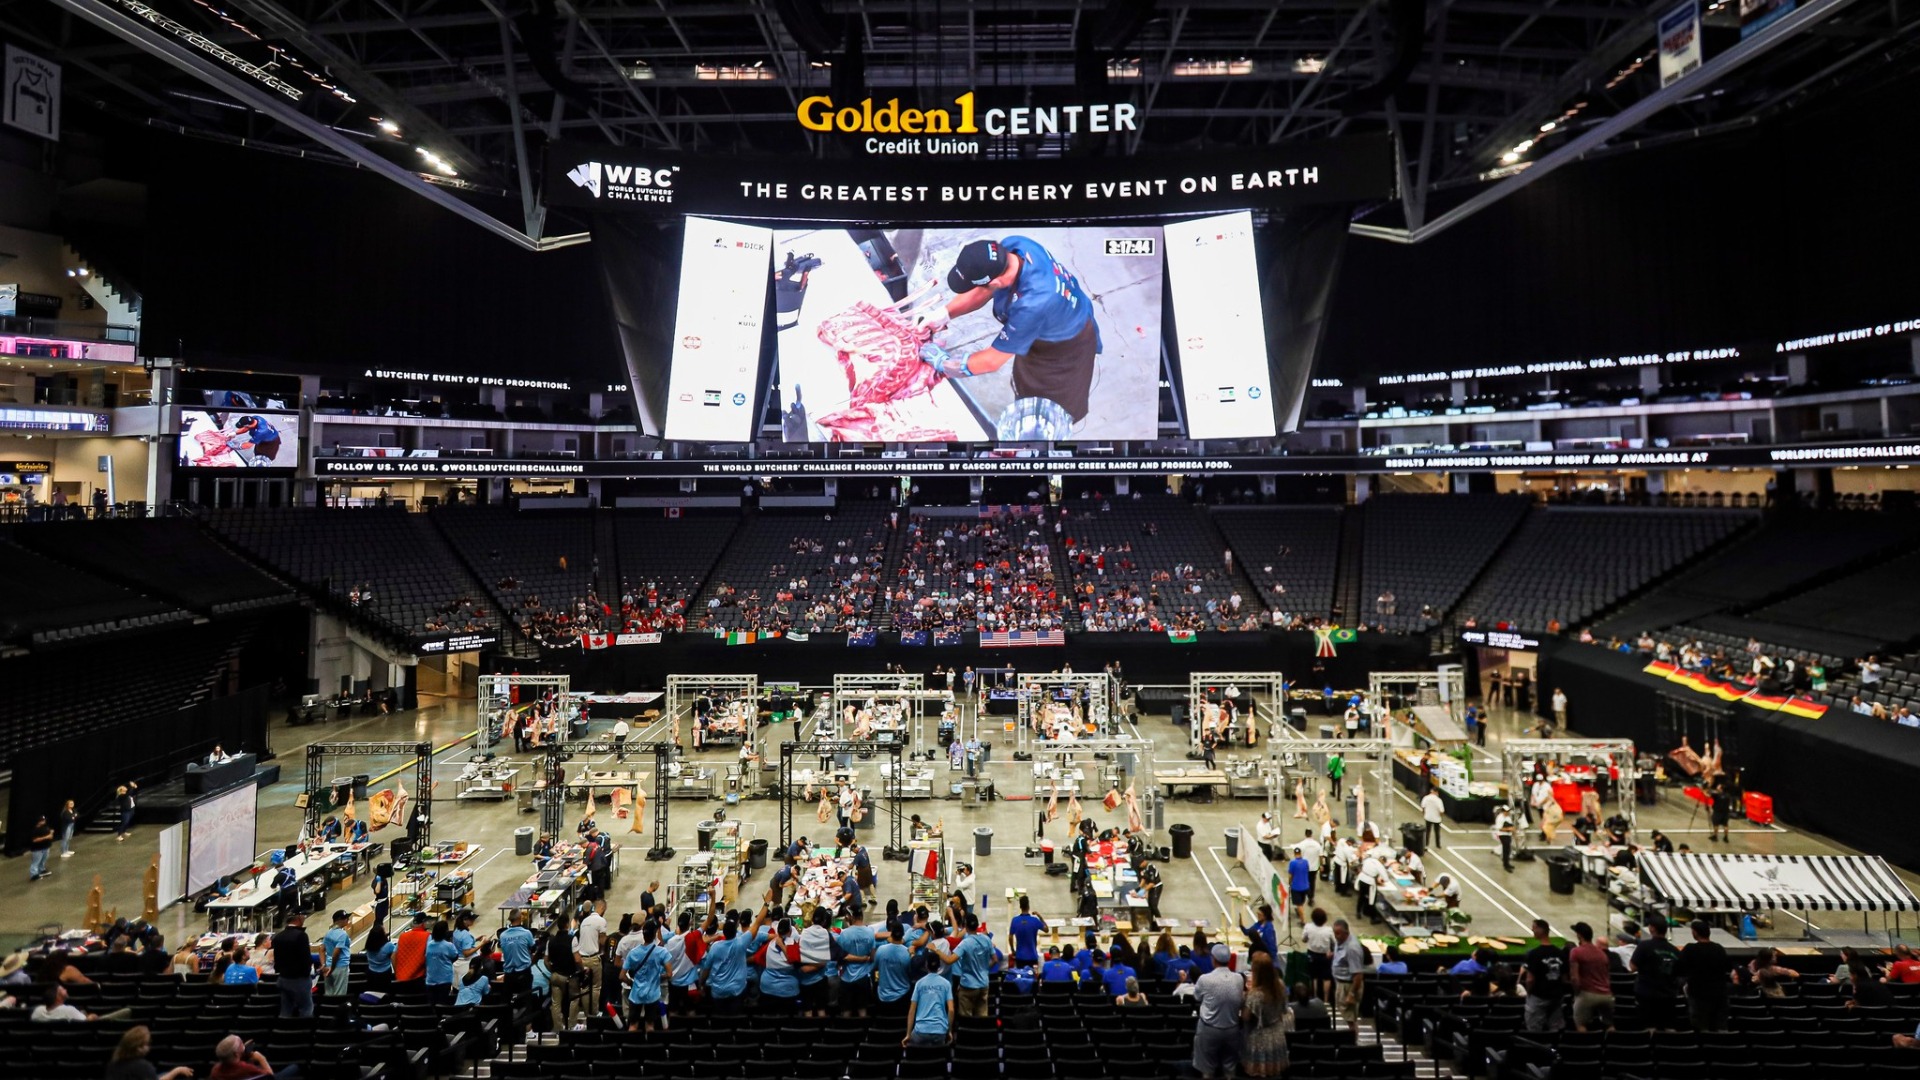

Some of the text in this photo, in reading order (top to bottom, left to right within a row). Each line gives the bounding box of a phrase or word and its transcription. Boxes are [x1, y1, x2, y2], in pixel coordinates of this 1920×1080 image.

[985, 103, 1137, 135] CENTER
[865, 138, 979, 154] Credit Union
[608, 185, 634, 193] WORLD
[741, 167, 1319, 202] THE GREATEST BUTCHERY EVENT ON EARTH
[608, 192, 673, 203] CHALLENGE
[744, 242, 764, 250] DICK
[1776, 319, 1920, 352] A BUTCHERY EVENT OF EPIC
[1451, 369, 1474, 380] NEW
[1666, 351, 1691, 363] GET
[1694, 347, 1740, 361] READY.
[376, 370, 430, 381] BUTCHERY
[433, 374, 464, 383] EVENT
[483, 378, 504, 386] EPIC
[506, 379, 571, 390] PROPORTIONS.
[328, 463, 373, 471] FOLLOW
[377, 463, 395, 471] US.
[398, 464, 419, 472] TAG
[422, 464, 439, 472] US.
[703, 464, 719, 472] THE
[722, 464, 752, 472] WORLD
[896, 463, 945, 471] PRESENTED
[949, 463, 960, 471] BY
[962, 463, 997, 471] GASCON
[1047, 462, 1076, 470] BENCH
[1078, 462, 1106, 470] CREEK
[1108, 462, 1138, 470] RANCH
[1140, 462, 1159, 470] AND
[1386, 452, 1709, 468] RESULTS ANNOUNCED TOMORROW NIGHT AND AVAILABLE AT
